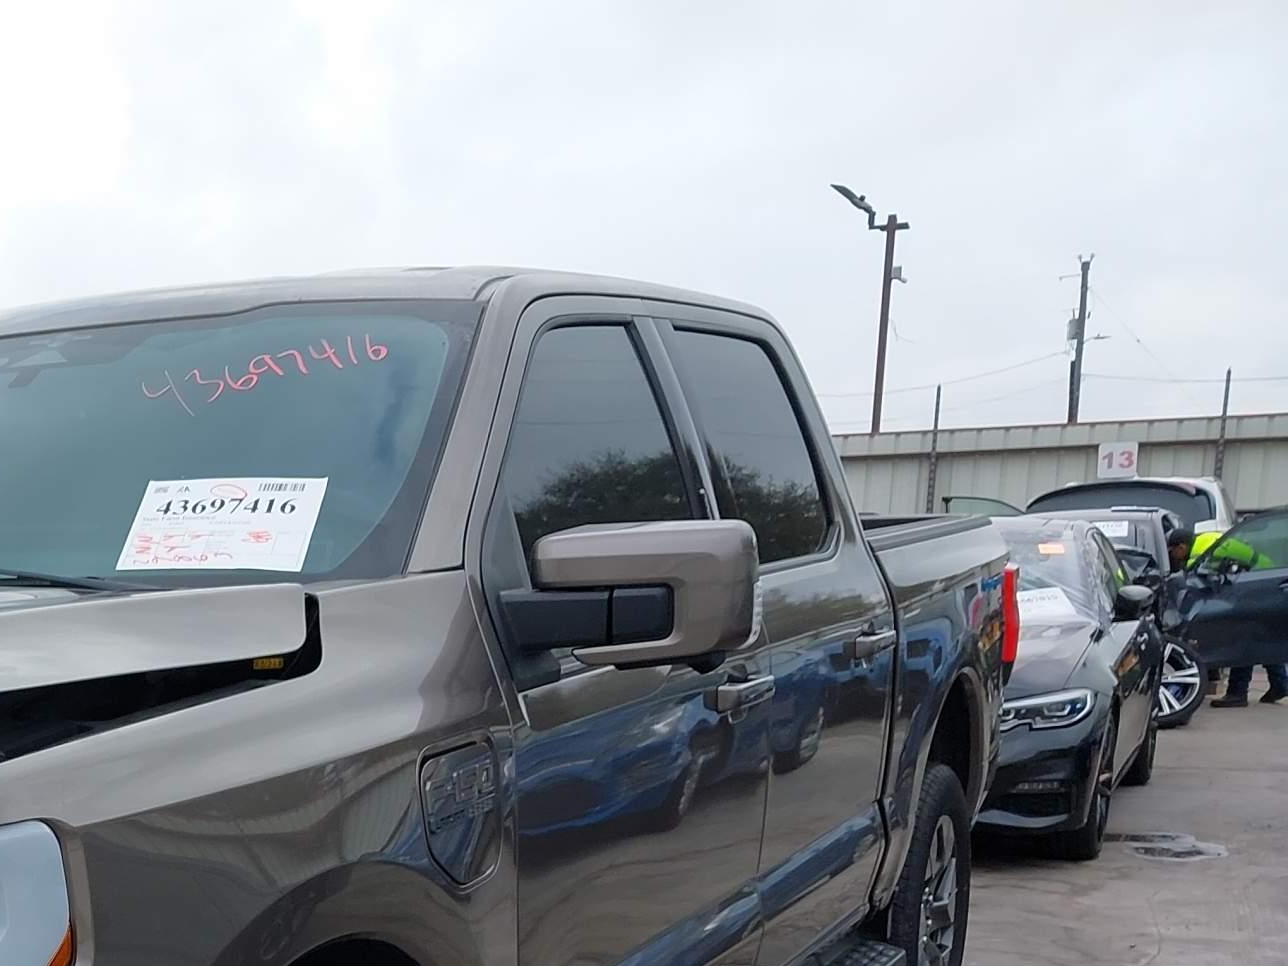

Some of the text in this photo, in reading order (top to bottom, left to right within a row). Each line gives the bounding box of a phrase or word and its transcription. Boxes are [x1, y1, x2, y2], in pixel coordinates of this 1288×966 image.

[141, 333, 389, 417] 43697416
[1102, 450, 1134, 470] 13
[155, 497, 297, 516] 43697416
